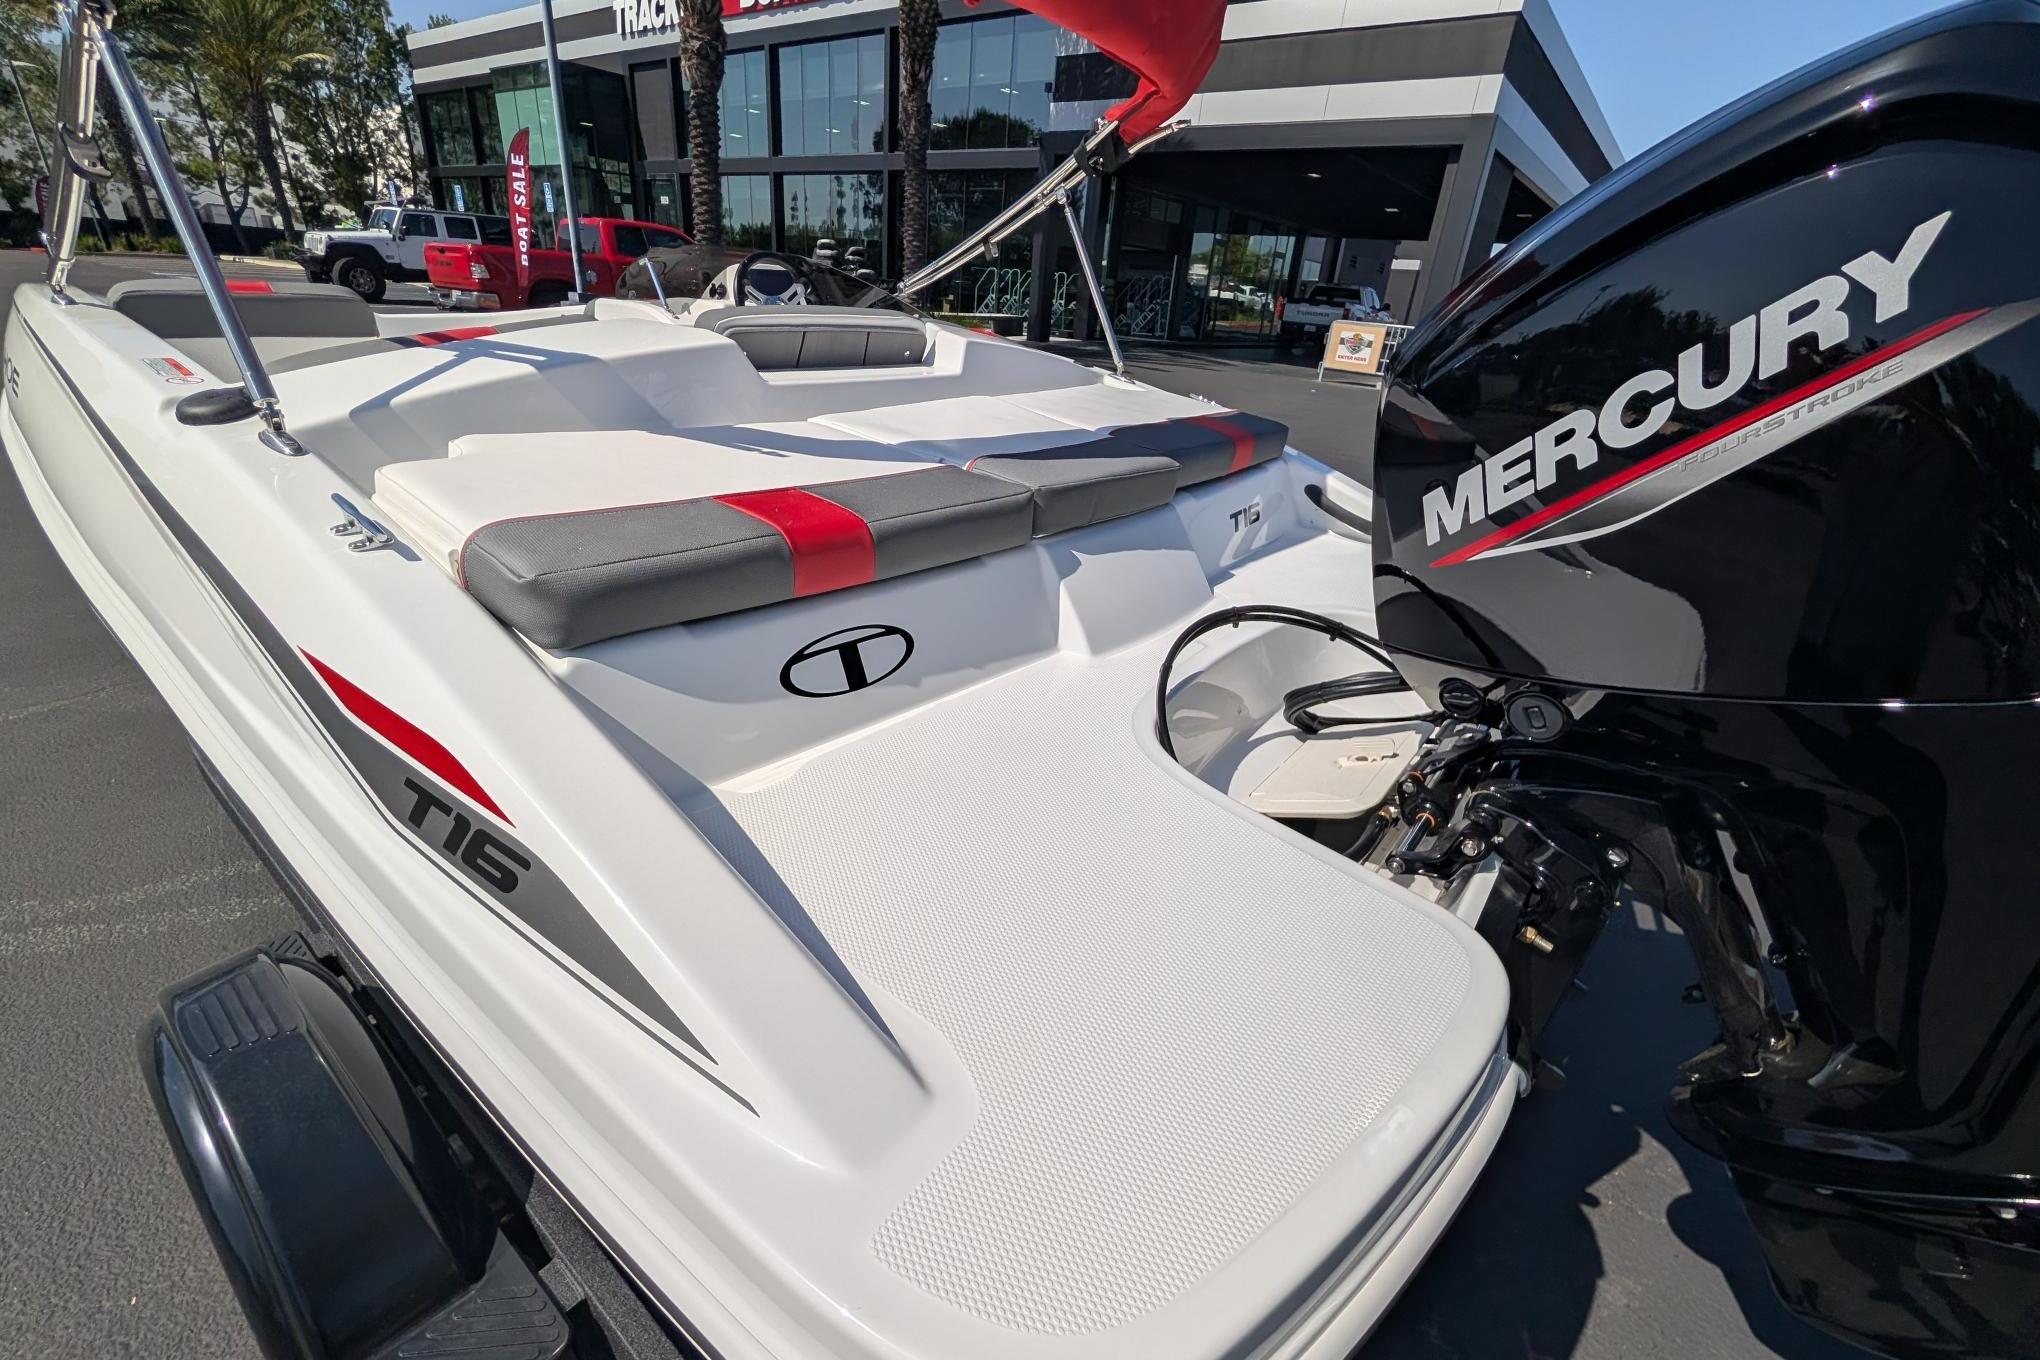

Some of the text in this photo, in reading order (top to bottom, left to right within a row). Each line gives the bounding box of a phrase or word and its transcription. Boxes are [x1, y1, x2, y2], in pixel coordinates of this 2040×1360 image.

[613, 0, 685, 34] TRACK
[511, 153, 529, 267] BOAT SALE
[1422, 210, 1952, 546] MERCURY
[1680, 359, 1904, 473] FOURSTROKE
[1230, 502, 1260, 533] T16
[404, 777, 531, 893] T16
